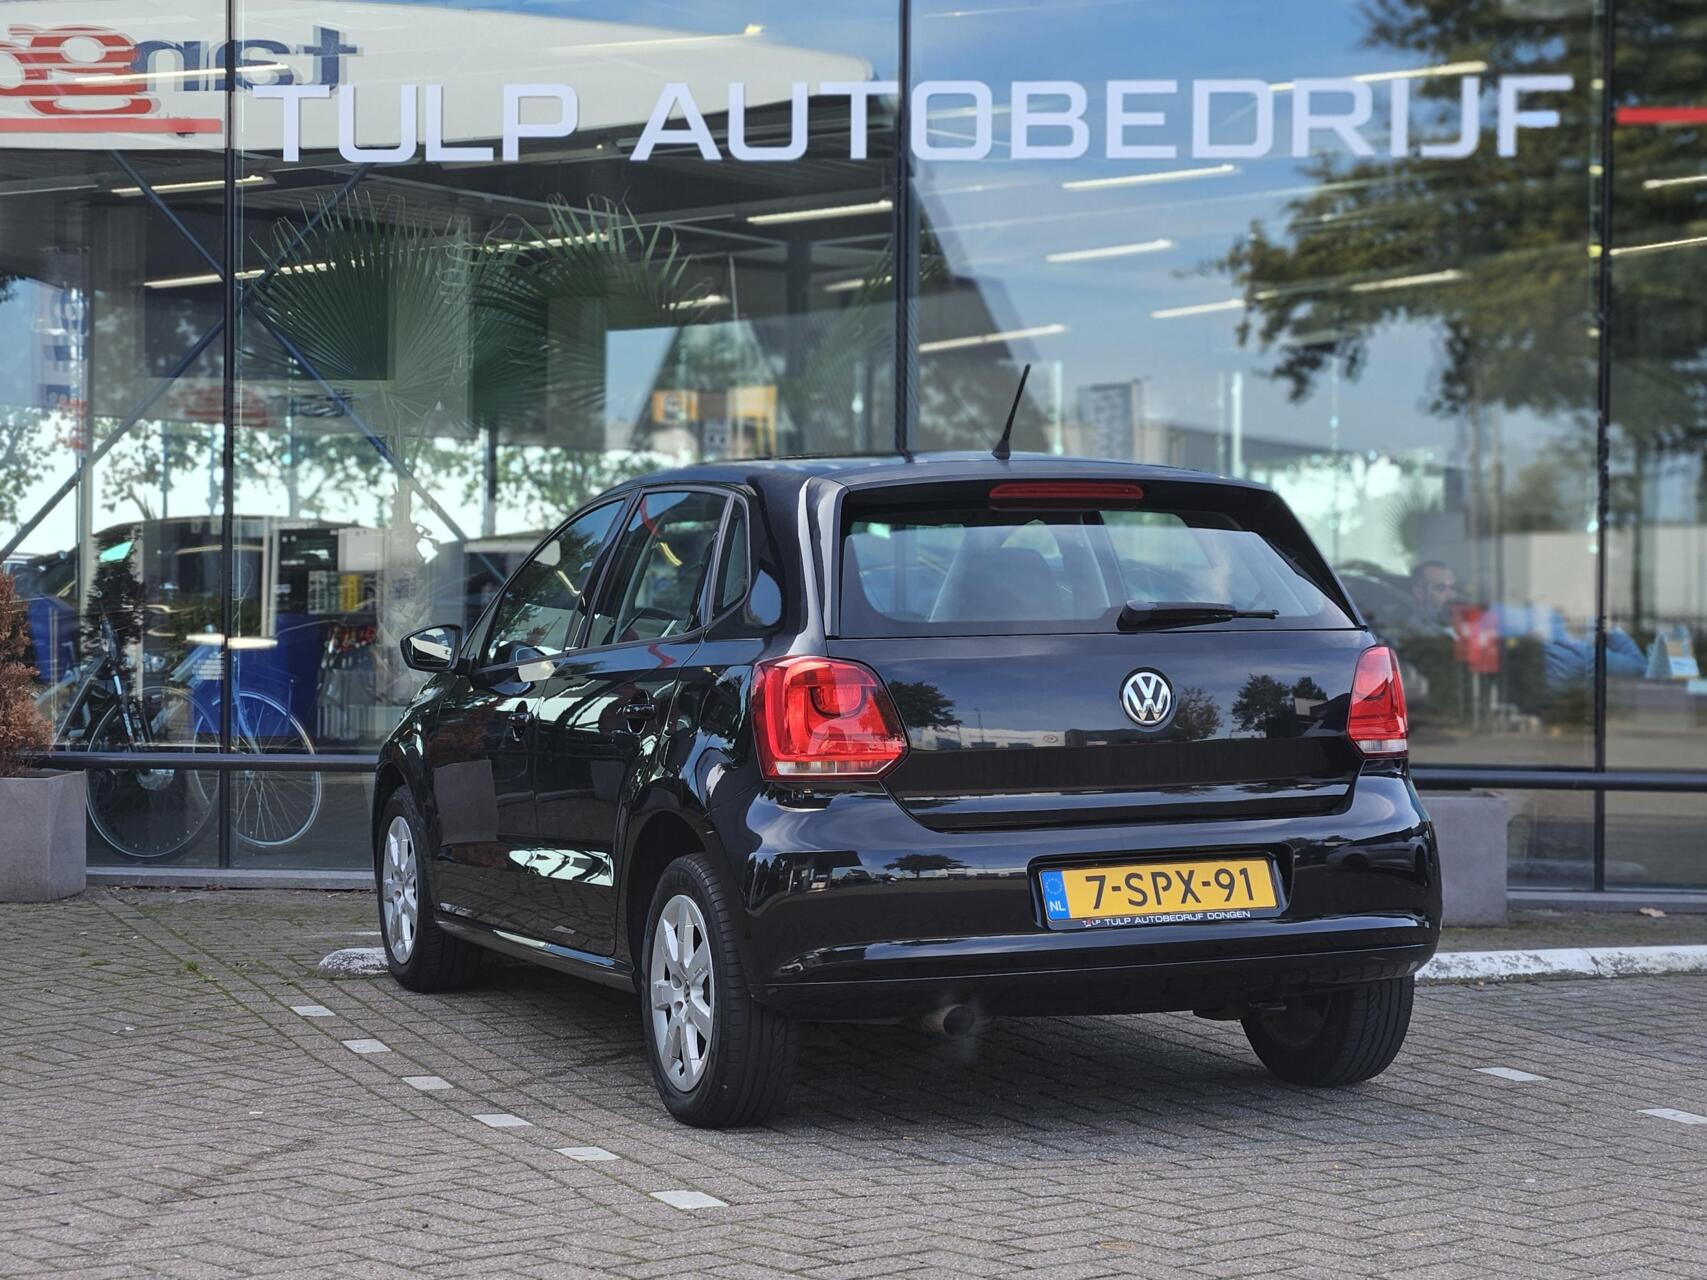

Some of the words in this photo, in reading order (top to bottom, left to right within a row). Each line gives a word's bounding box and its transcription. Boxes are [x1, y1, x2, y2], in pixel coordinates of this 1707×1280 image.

[253, 84, 579, 164] TULP
[631, 76, 1574, 162] AUTOBEDRIJF
[1085, 867, 1254, 910] 7-SPX-91
[1050, 900, 1066, 912] NL
[1104, 917, 1132, 926] TULP
[1134, 911, 1204, 924] AUTOBEDRIJF
[1207, 910, 1251, 921] DONGEN
